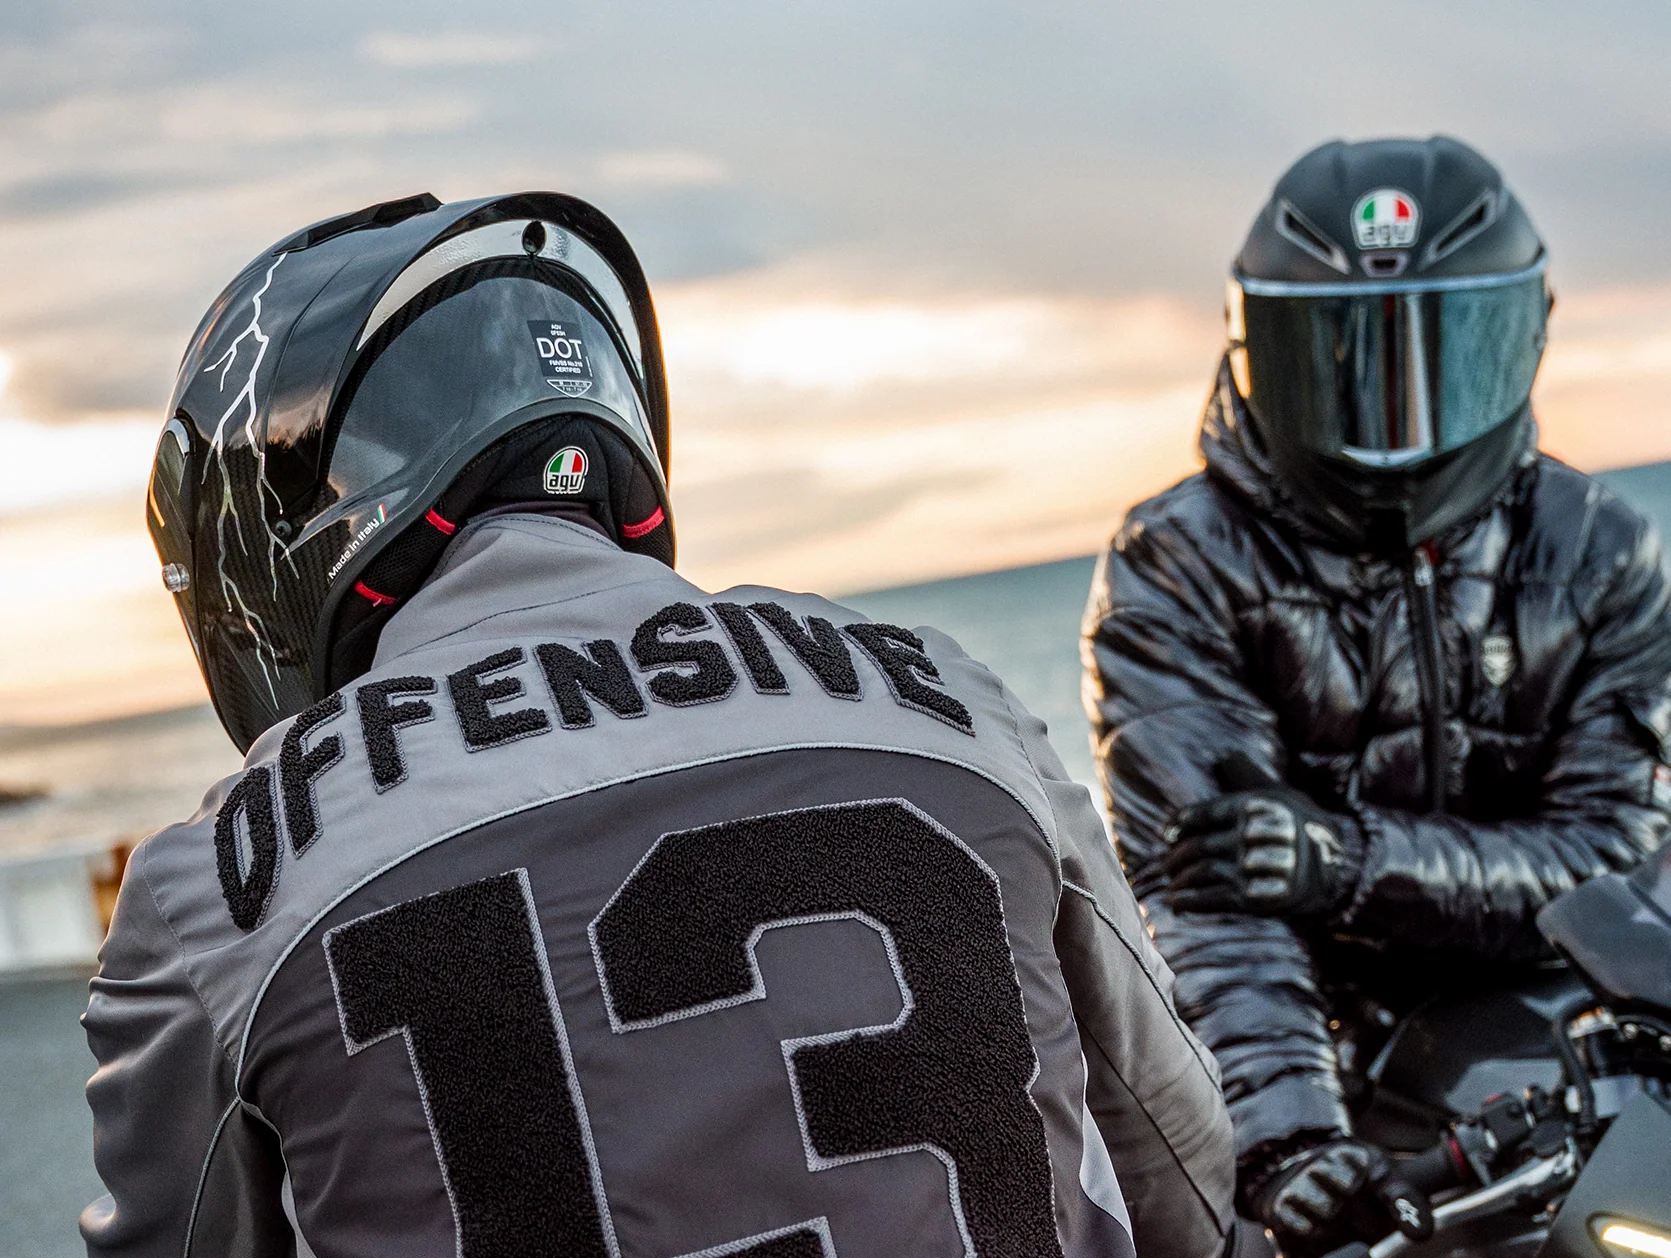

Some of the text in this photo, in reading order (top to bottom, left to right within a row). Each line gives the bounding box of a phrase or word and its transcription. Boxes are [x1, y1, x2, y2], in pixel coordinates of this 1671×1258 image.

[536, 337, 582, 360] DOT
[549, 474, 580, 492] agv
[328, 550, 351, 579] Made
[358, 518, 380, 541] Italy
[214, 602, 976, 931] OFFENSIVE
